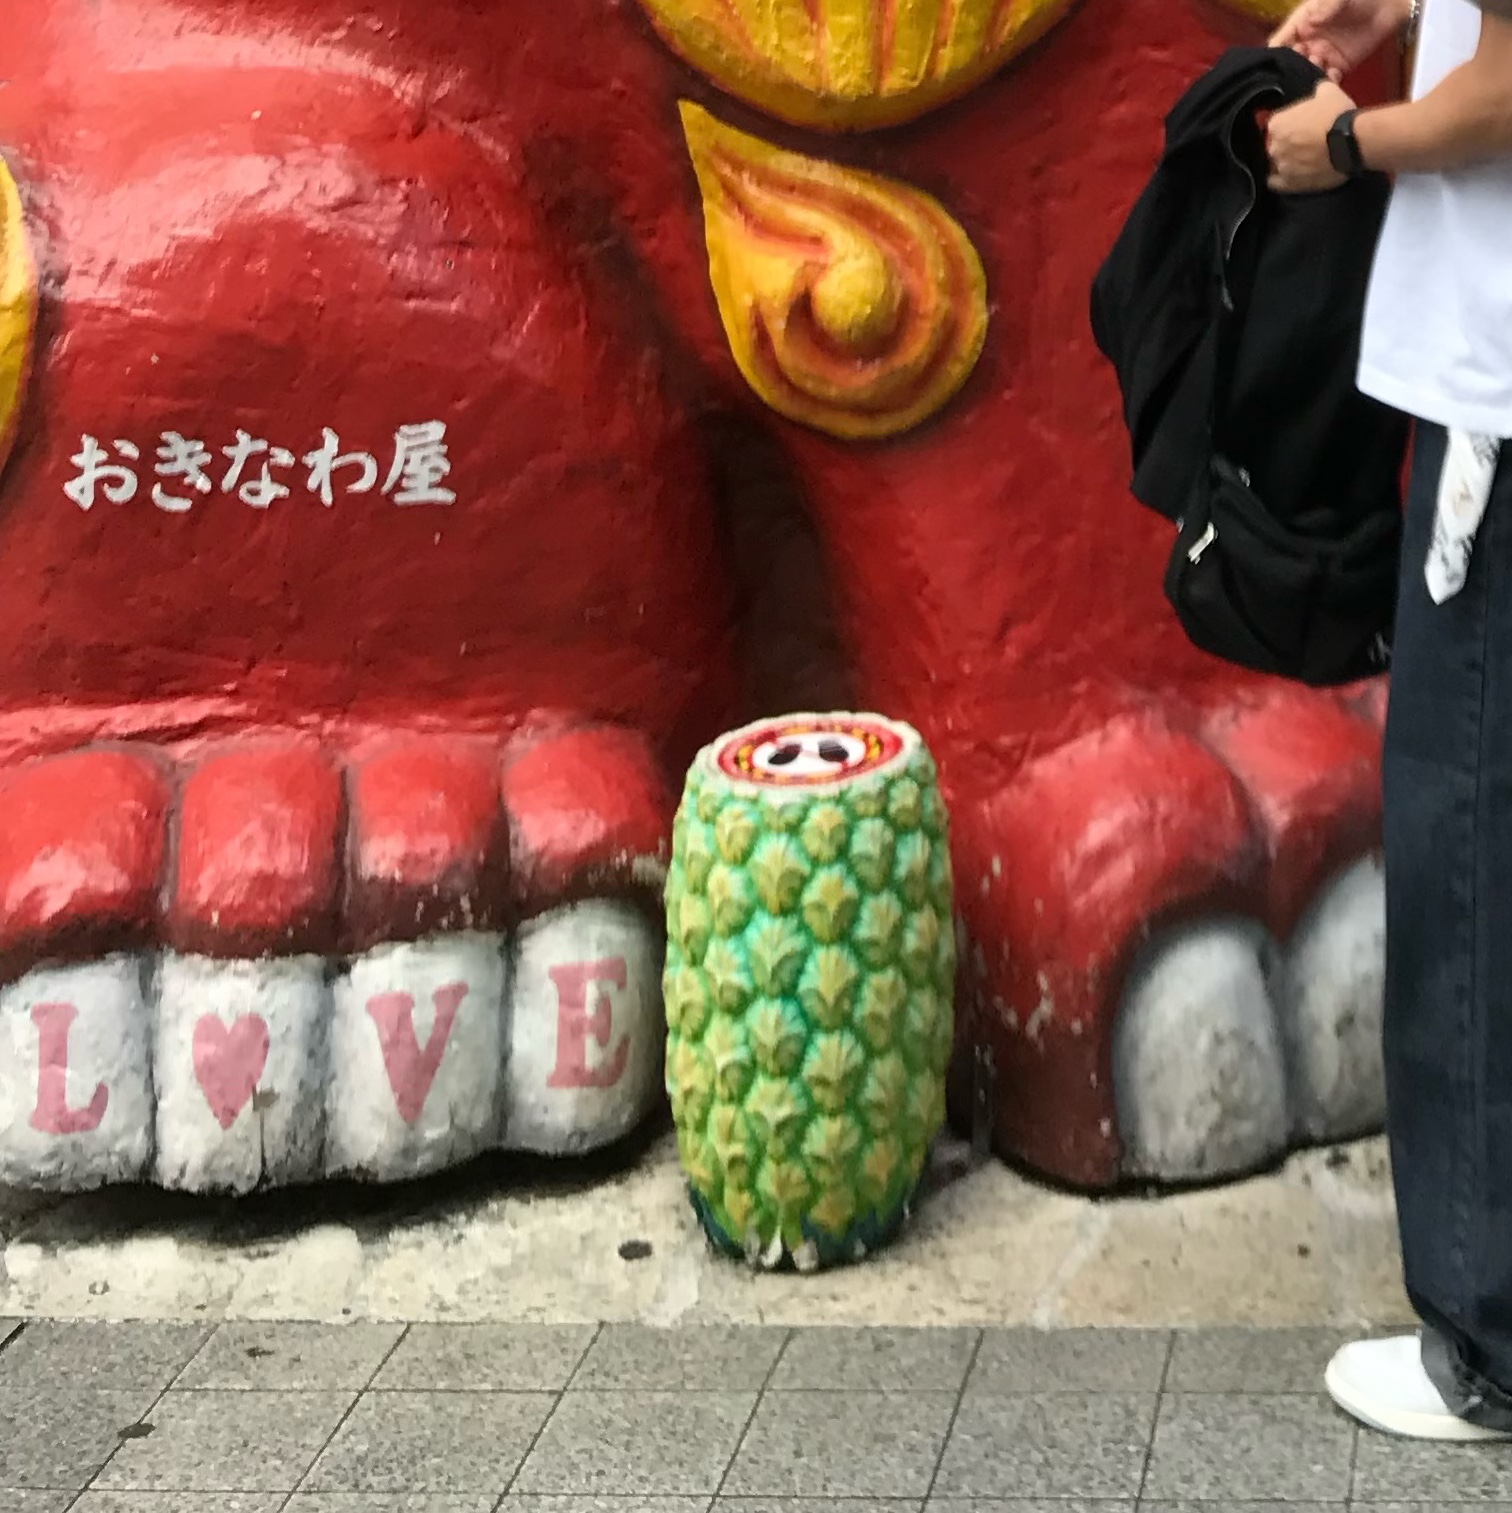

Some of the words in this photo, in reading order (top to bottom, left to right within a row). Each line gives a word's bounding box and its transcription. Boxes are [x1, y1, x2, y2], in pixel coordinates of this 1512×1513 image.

[62, 419, 457, 513] おきなわ屋
